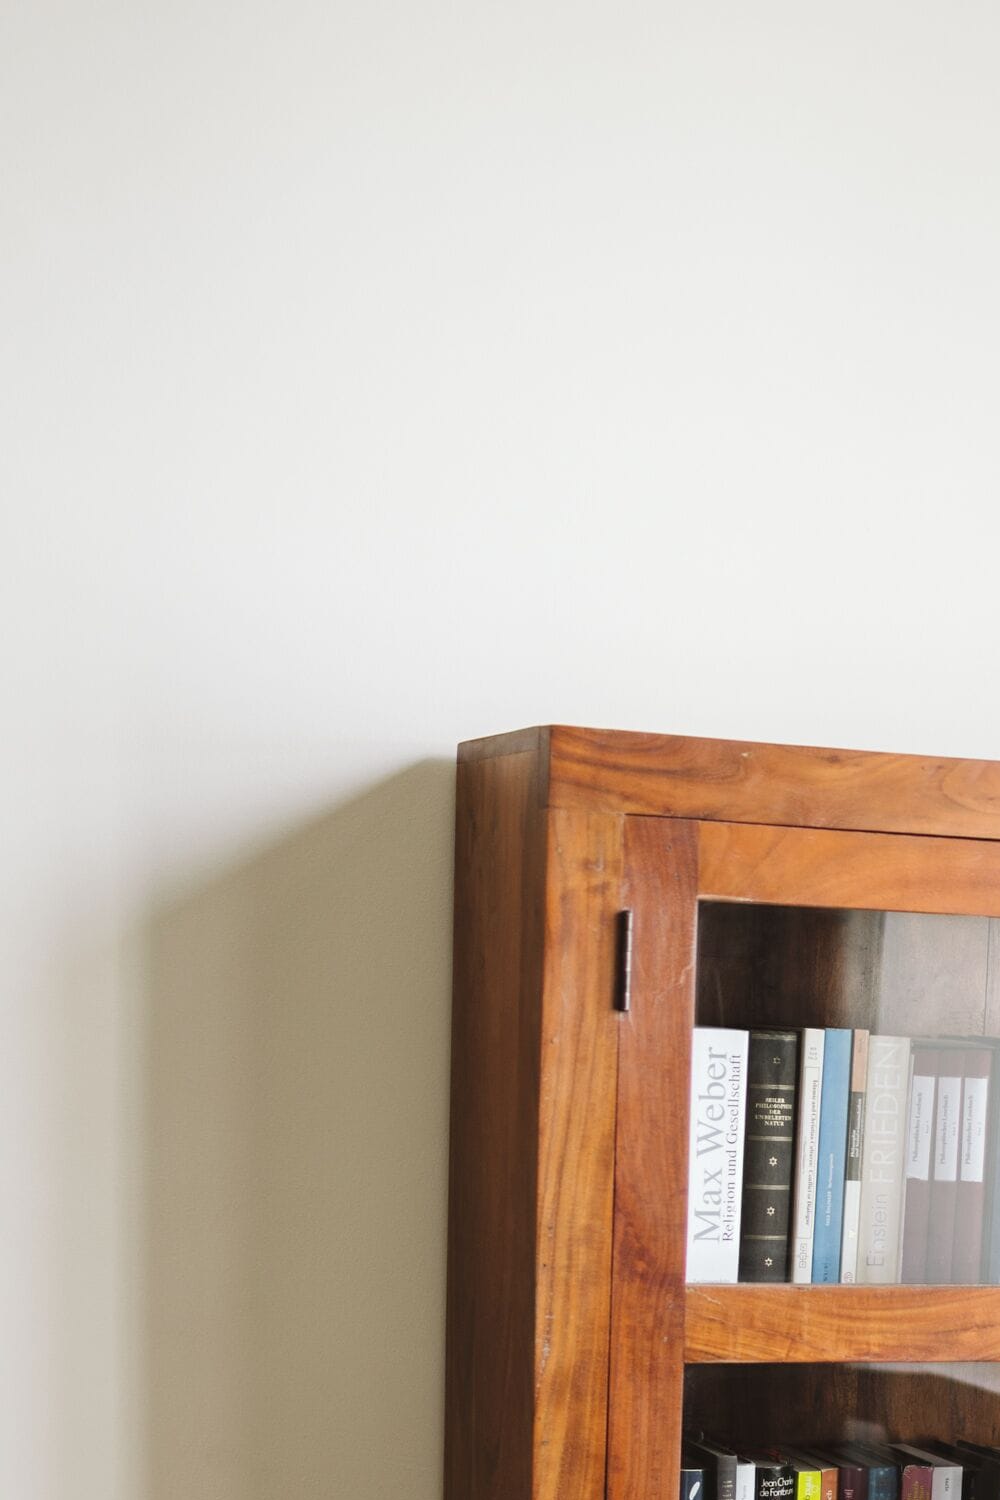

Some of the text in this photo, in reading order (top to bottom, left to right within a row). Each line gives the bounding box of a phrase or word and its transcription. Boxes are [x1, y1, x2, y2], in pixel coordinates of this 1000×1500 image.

[693, 1047, 728, 1242] Max Weber
[722, 1054, 741, 1242] Religion und Gesellschaft
[866, 1042, 904, 1267] Einstein FRIEDEN
[760, 1489, 769, 1497] de
[761, 1478, 777, 1489] Jean
